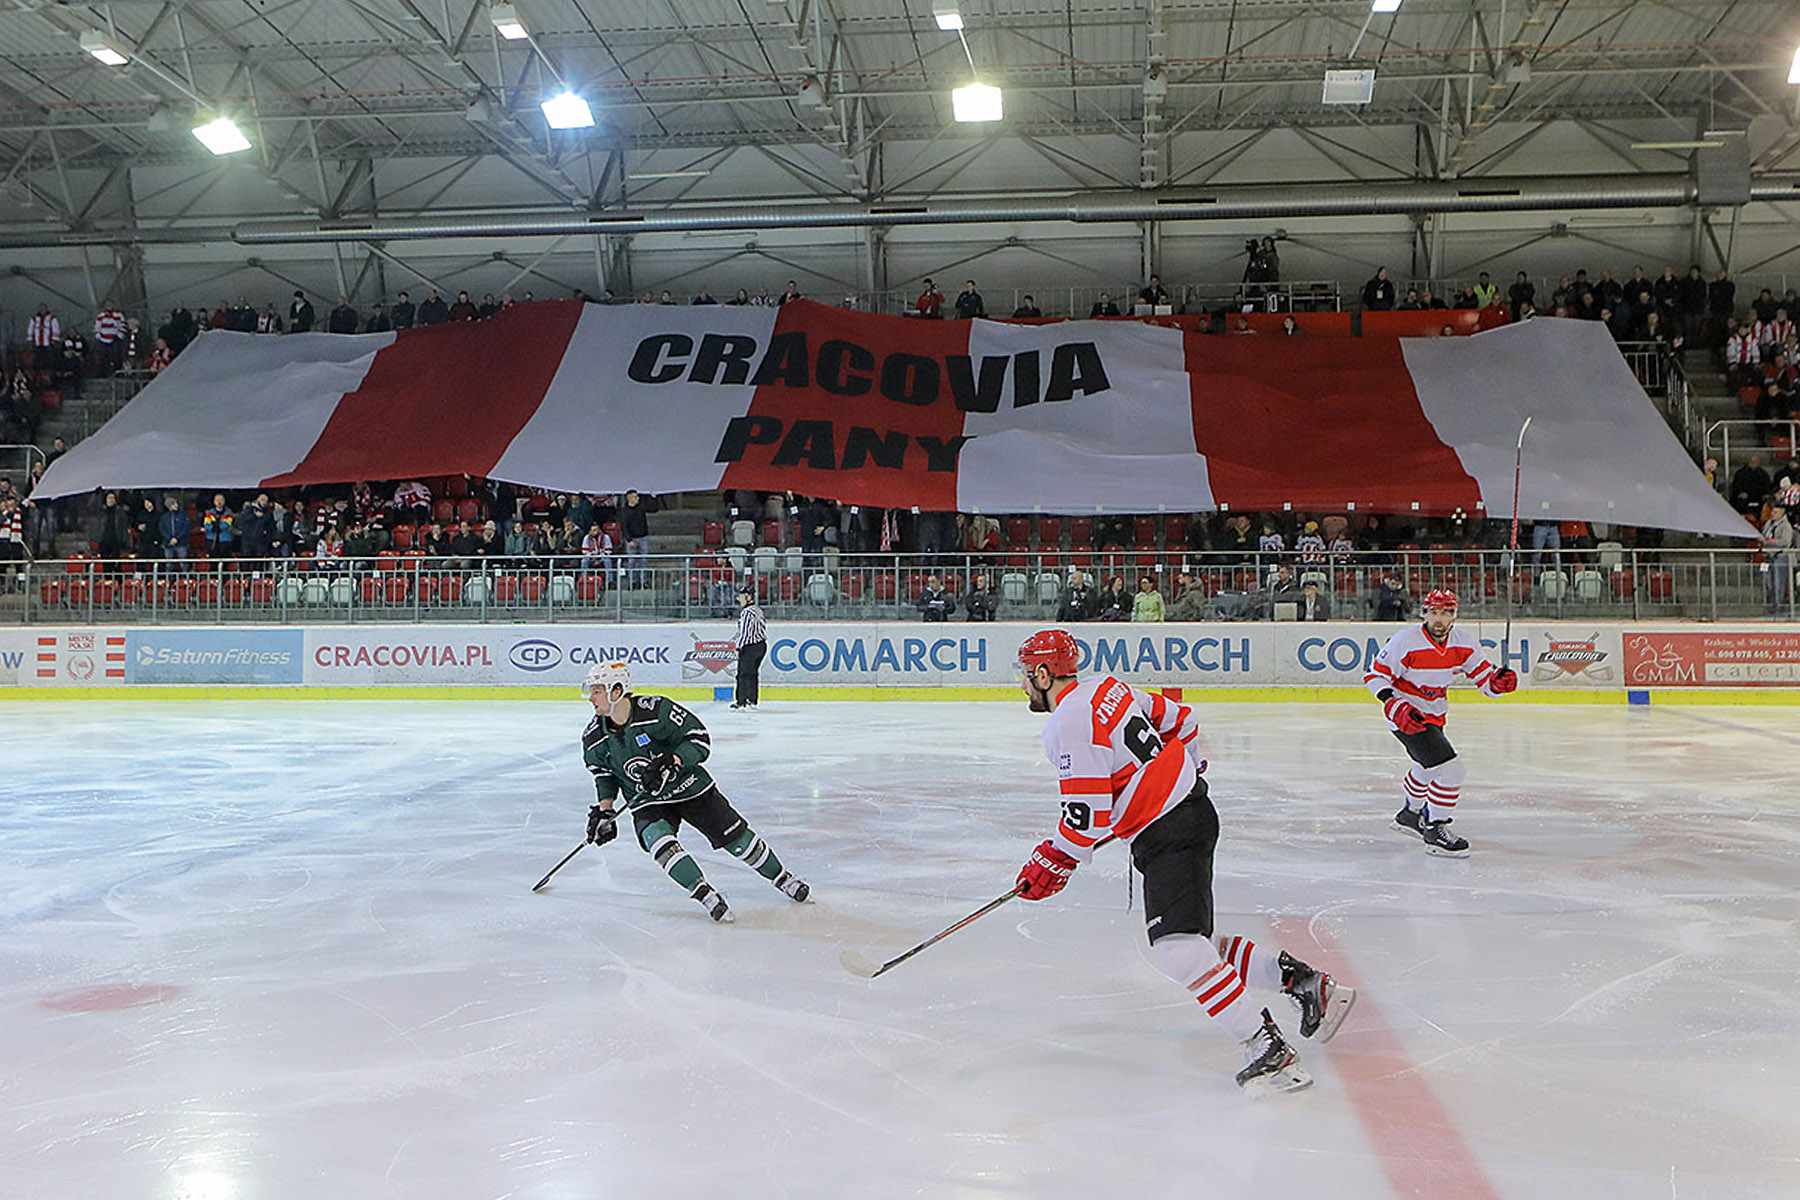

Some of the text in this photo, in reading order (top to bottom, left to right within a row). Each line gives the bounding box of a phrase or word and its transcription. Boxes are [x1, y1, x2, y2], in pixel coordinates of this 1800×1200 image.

[628, 332, 1111, 413] CRACOVIA
[715, 416, 977, 473] PANY
[0, 652, 24, 669] W
[314, 645, 493, 667] CRACOVIA.PL
[569, 647, 670, 664] CANPACK
[689, 650, 736, 659] CRACOVI
[770, 638, 986, 672] COMARCH
[1076, 637, 1250, 672] OMARCH
[1060, 801, 1091, 831] 9
